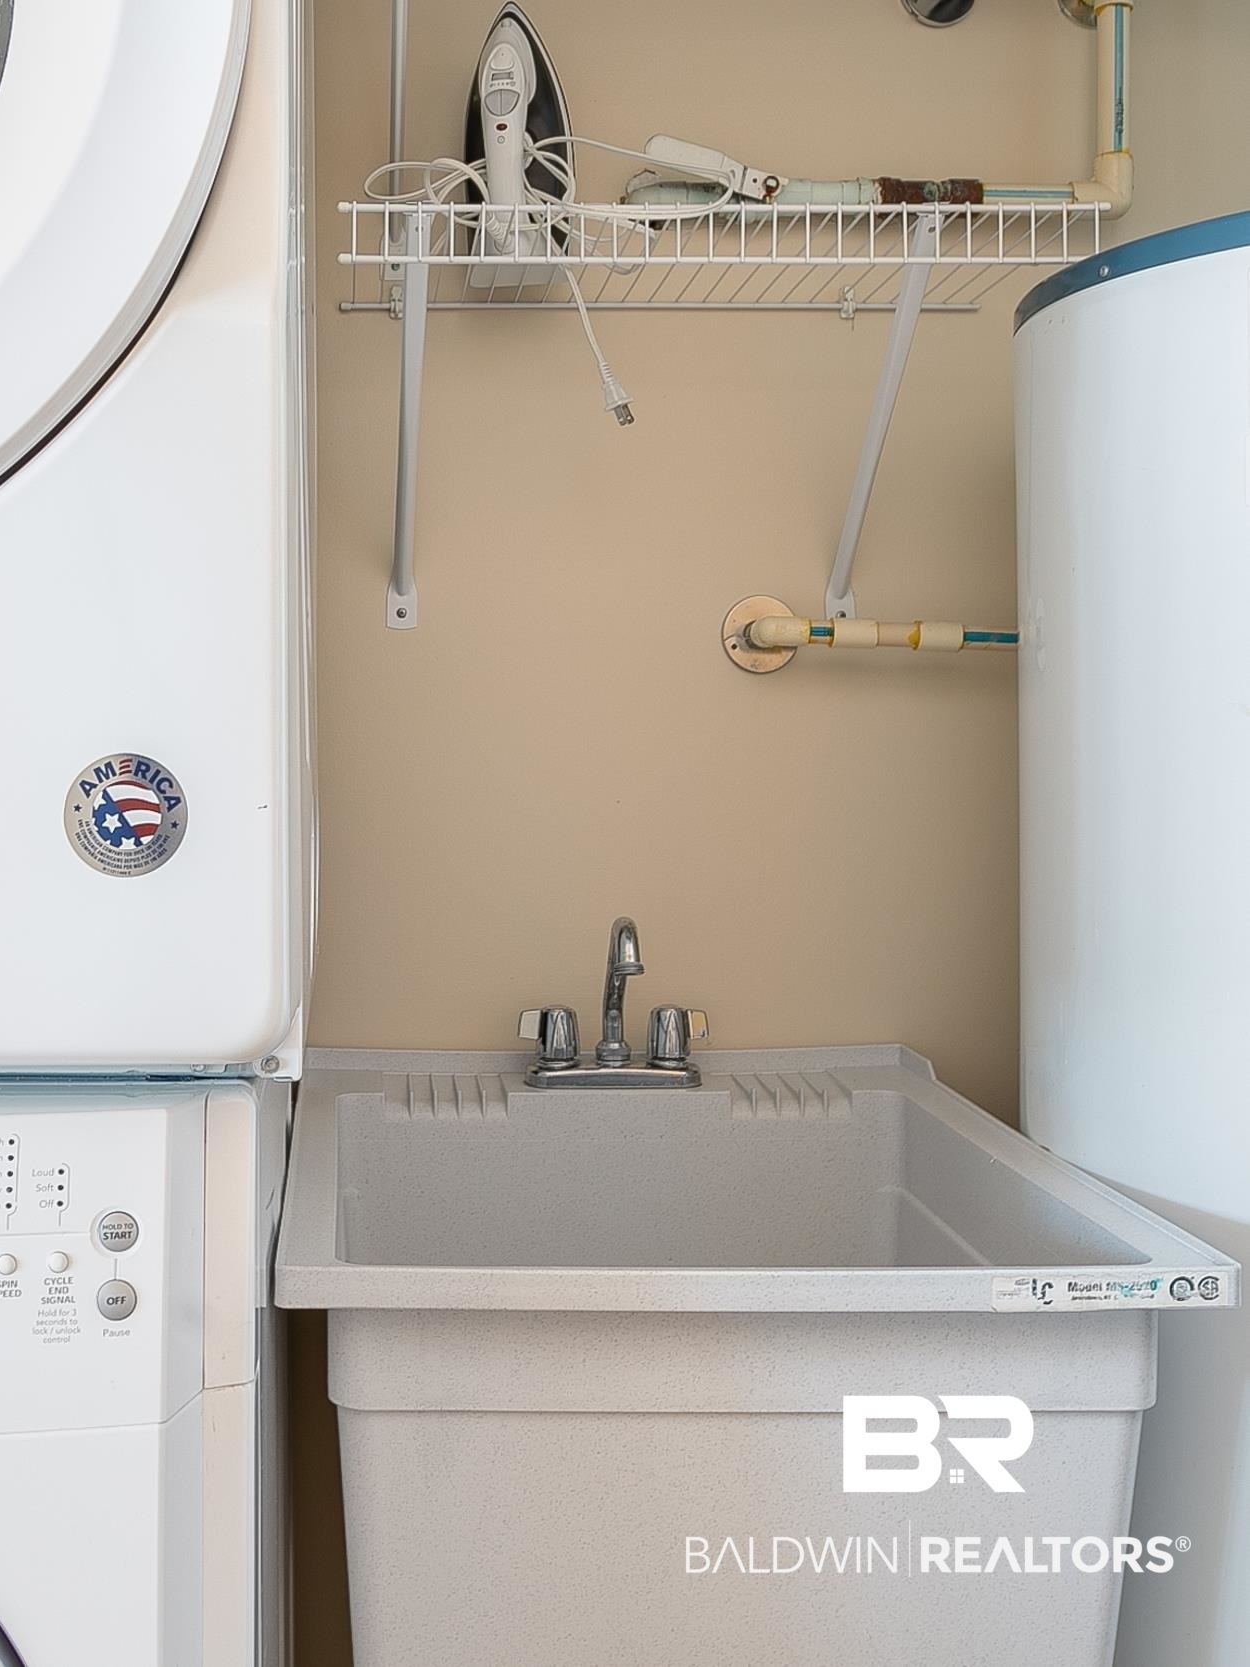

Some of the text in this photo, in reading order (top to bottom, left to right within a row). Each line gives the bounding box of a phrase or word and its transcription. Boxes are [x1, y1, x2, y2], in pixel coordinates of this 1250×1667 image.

[78, 758, 181, 813] AMERICA
[32, 1168, 54, 1177] Loud
[36, 1184, 54, 1192] Soft
[39, 1200, 54, 1208] Off
[102, 1223, 123, 1231] HOLD
[103, 1231, 132, 1240] START
[44, 1277, 74, 1286] CYCLE
[49, 1287, 69, 1295] END
[41, 1296, 75, 1304] SIGNAL
[106, 1296, 126, 1305] OFF
[32, 1327, 47, 1335] lock
[55, 1326, 80, 1334] unlock
[103, 1328, 130, 1337] Pause
